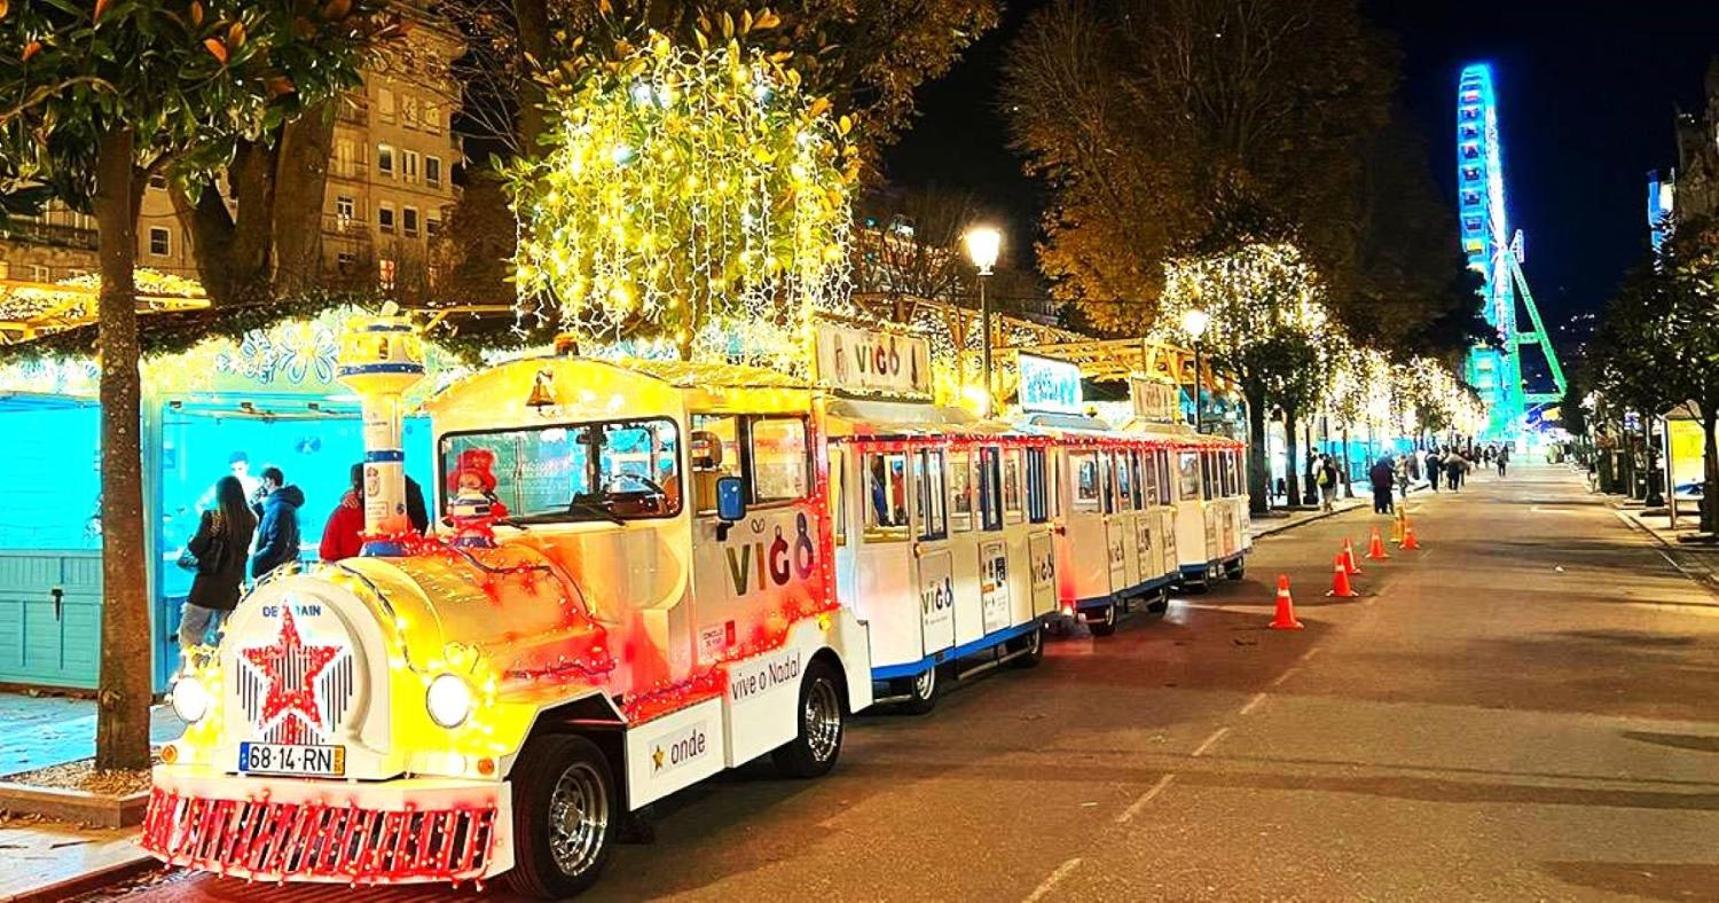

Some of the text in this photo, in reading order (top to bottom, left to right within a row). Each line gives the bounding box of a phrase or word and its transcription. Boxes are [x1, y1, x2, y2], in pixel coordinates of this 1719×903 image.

[726, 511, 815, 597] VIGO
[921, 577, 952, 615] VIGO
[731, 652, 801, 700] vive o Nadal
[670, 728, 706, 765] onde
